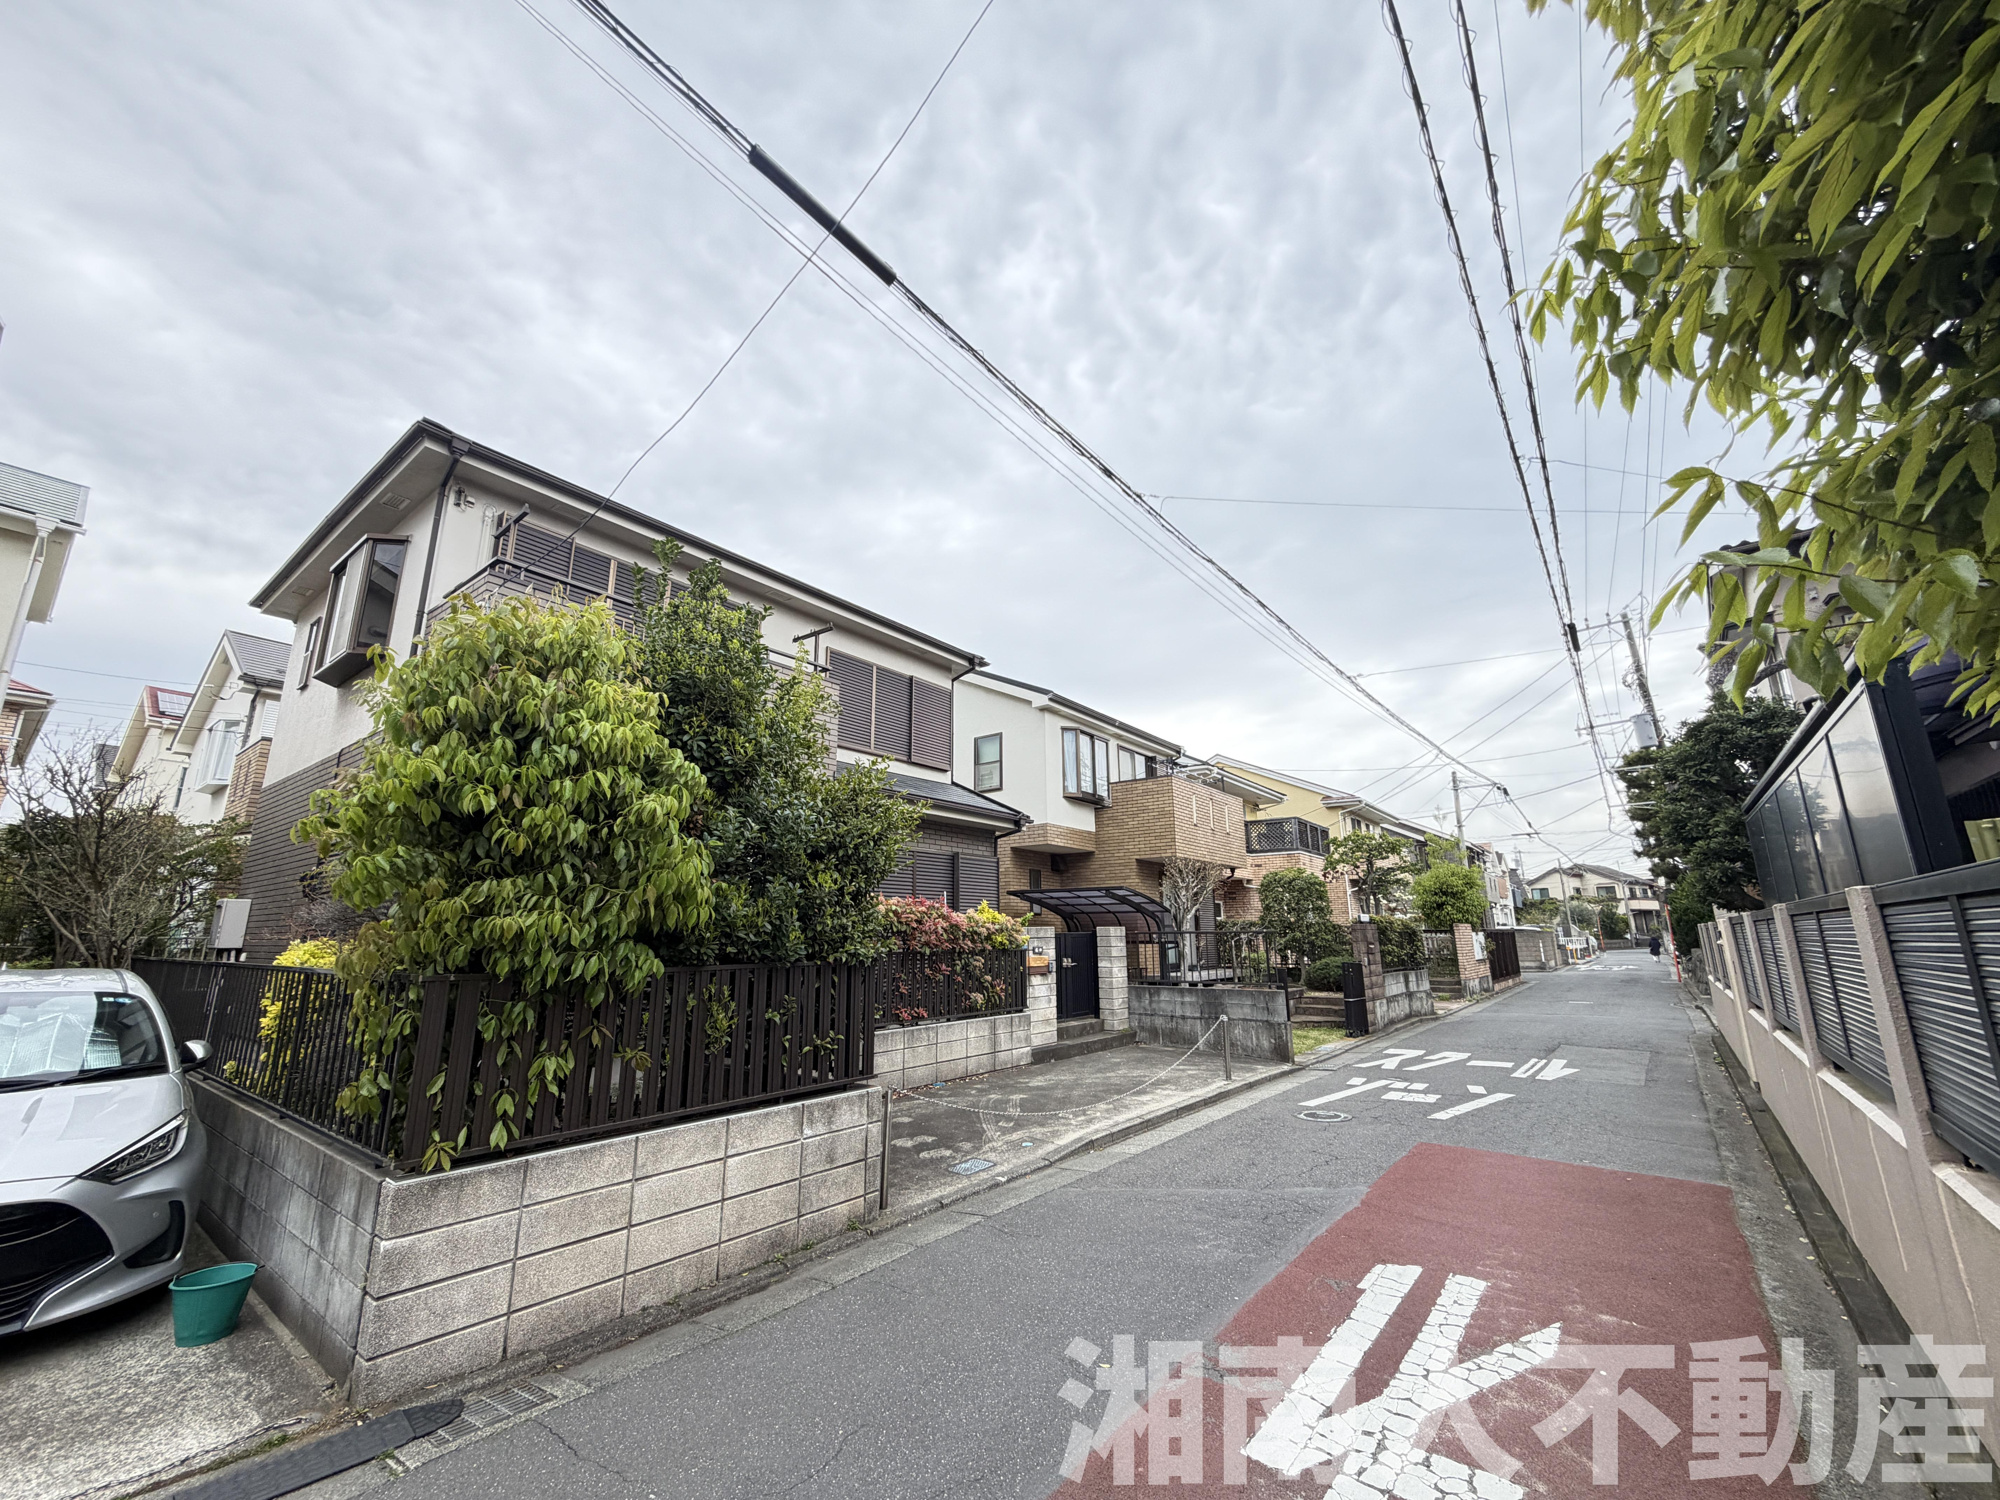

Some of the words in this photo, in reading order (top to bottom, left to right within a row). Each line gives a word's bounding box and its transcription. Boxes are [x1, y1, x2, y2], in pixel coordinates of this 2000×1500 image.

[1353, 1048, 1580, 1080] スクール
[1297, 1077, 1516, 1120] ゾーン
